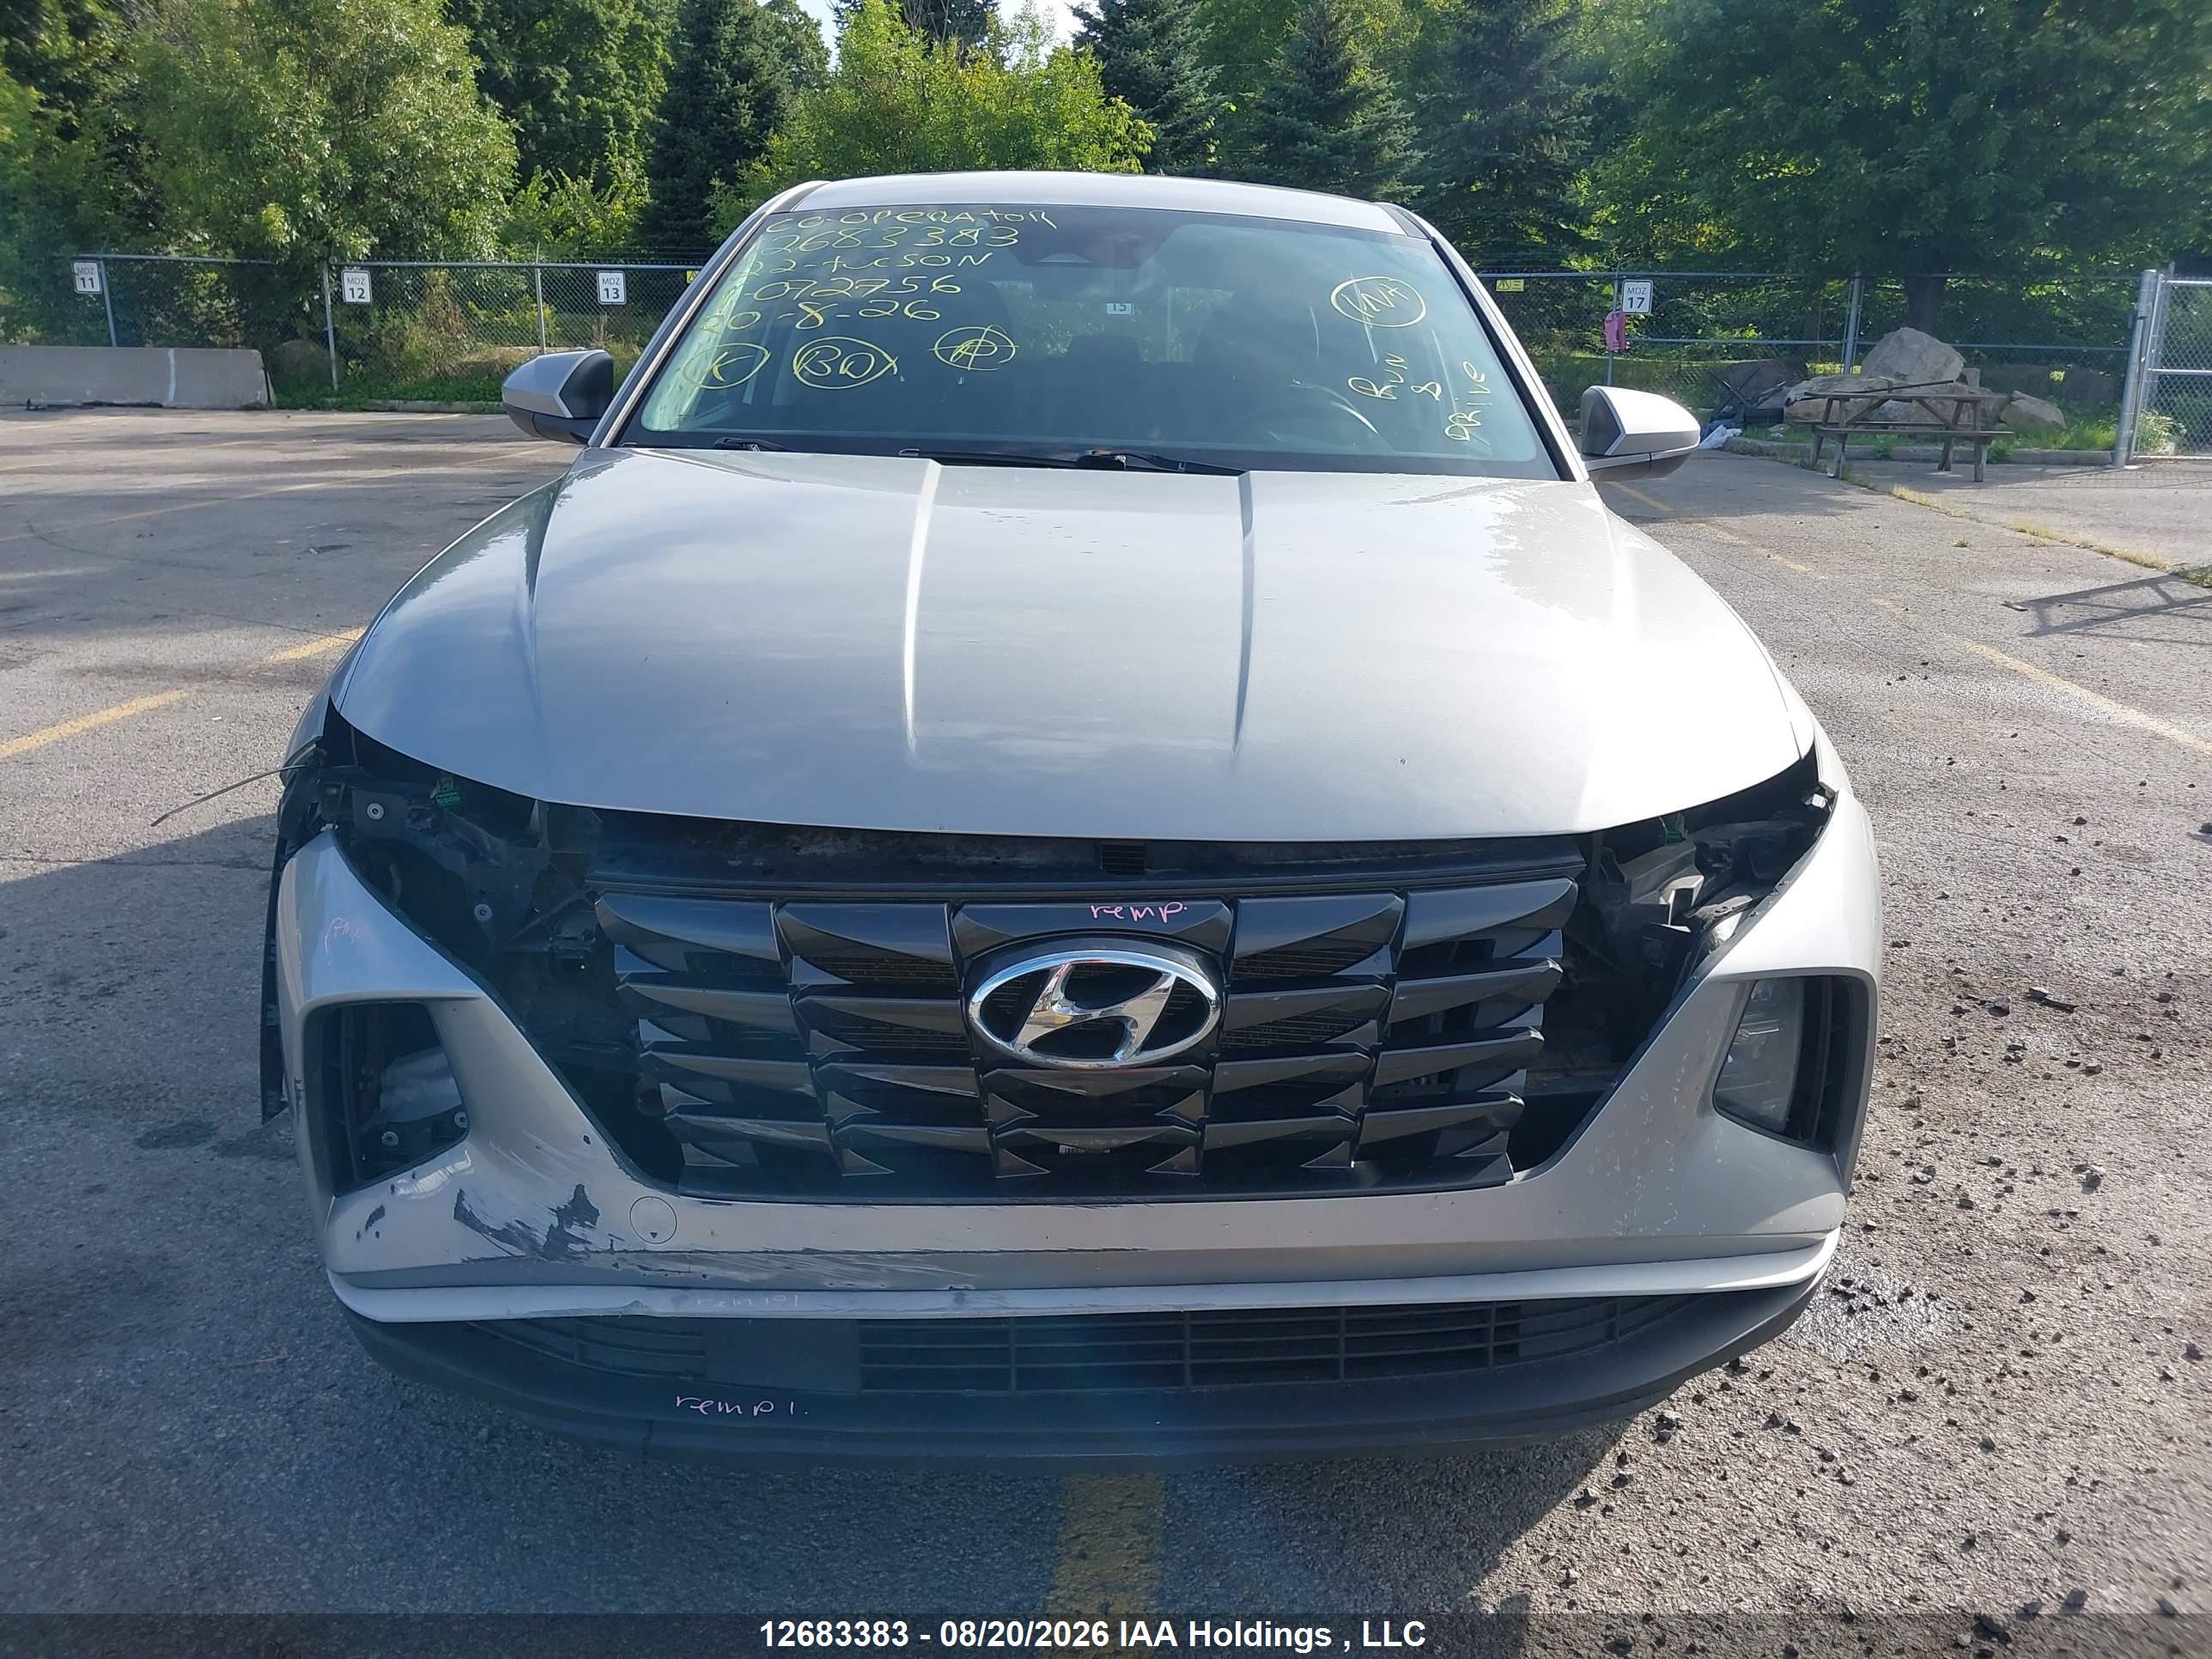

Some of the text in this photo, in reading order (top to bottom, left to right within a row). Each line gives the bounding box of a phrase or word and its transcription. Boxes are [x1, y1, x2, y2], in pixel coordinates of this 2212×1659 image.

[80, 276, 94, 289] 11
[347, 276, 365, 285] MDZ
[602, 276, 620, 285] MDZ
[349, 287, 366, 300] 12
[604, 287, 620, 300] 13
[1626, 287, 1647, 295] MDZ
[1627, 296, 1645, 309] 17
